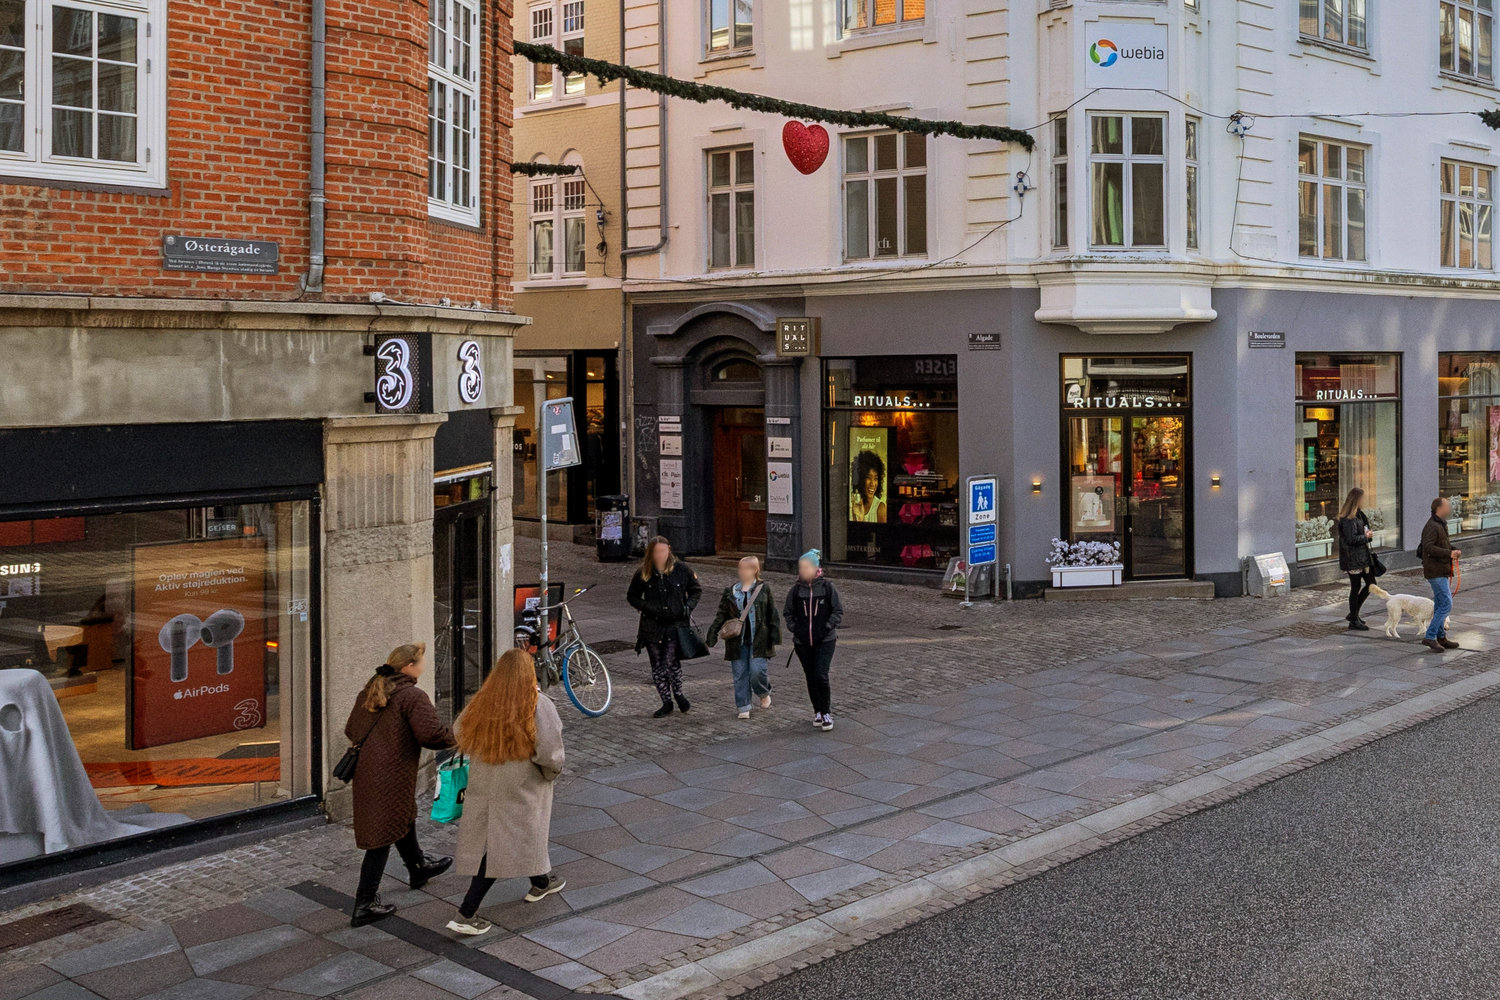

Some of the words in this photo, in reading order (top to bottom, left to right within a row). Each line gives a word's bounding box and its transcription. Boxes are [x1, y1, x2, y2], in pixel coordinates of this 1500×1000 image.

[1121, 46, 1164, 60] webia
[184, 240, 261, 256] Østerågade
[377, 338, 413, 410] 3
[458, 340, 482, 403] 3
[854, 395, 931, 407] RITUALS...
[1315, 389, 1378, 400] RITUALS...
[1073, 396, 1181, 408] RITUALS...
[975, 513, 990, 521] Zone
[0, 562, 41, 576] SUNG
[158, 572, 188, 582] Oplev
[189, 569, 225, 580] magien
[226, 566, 245, 575] ved
[154, 582, 181, 592] Aktiv
[183, 575, 249, 589] støjreduktion.
[183, 683, 230, 698] AirPods
